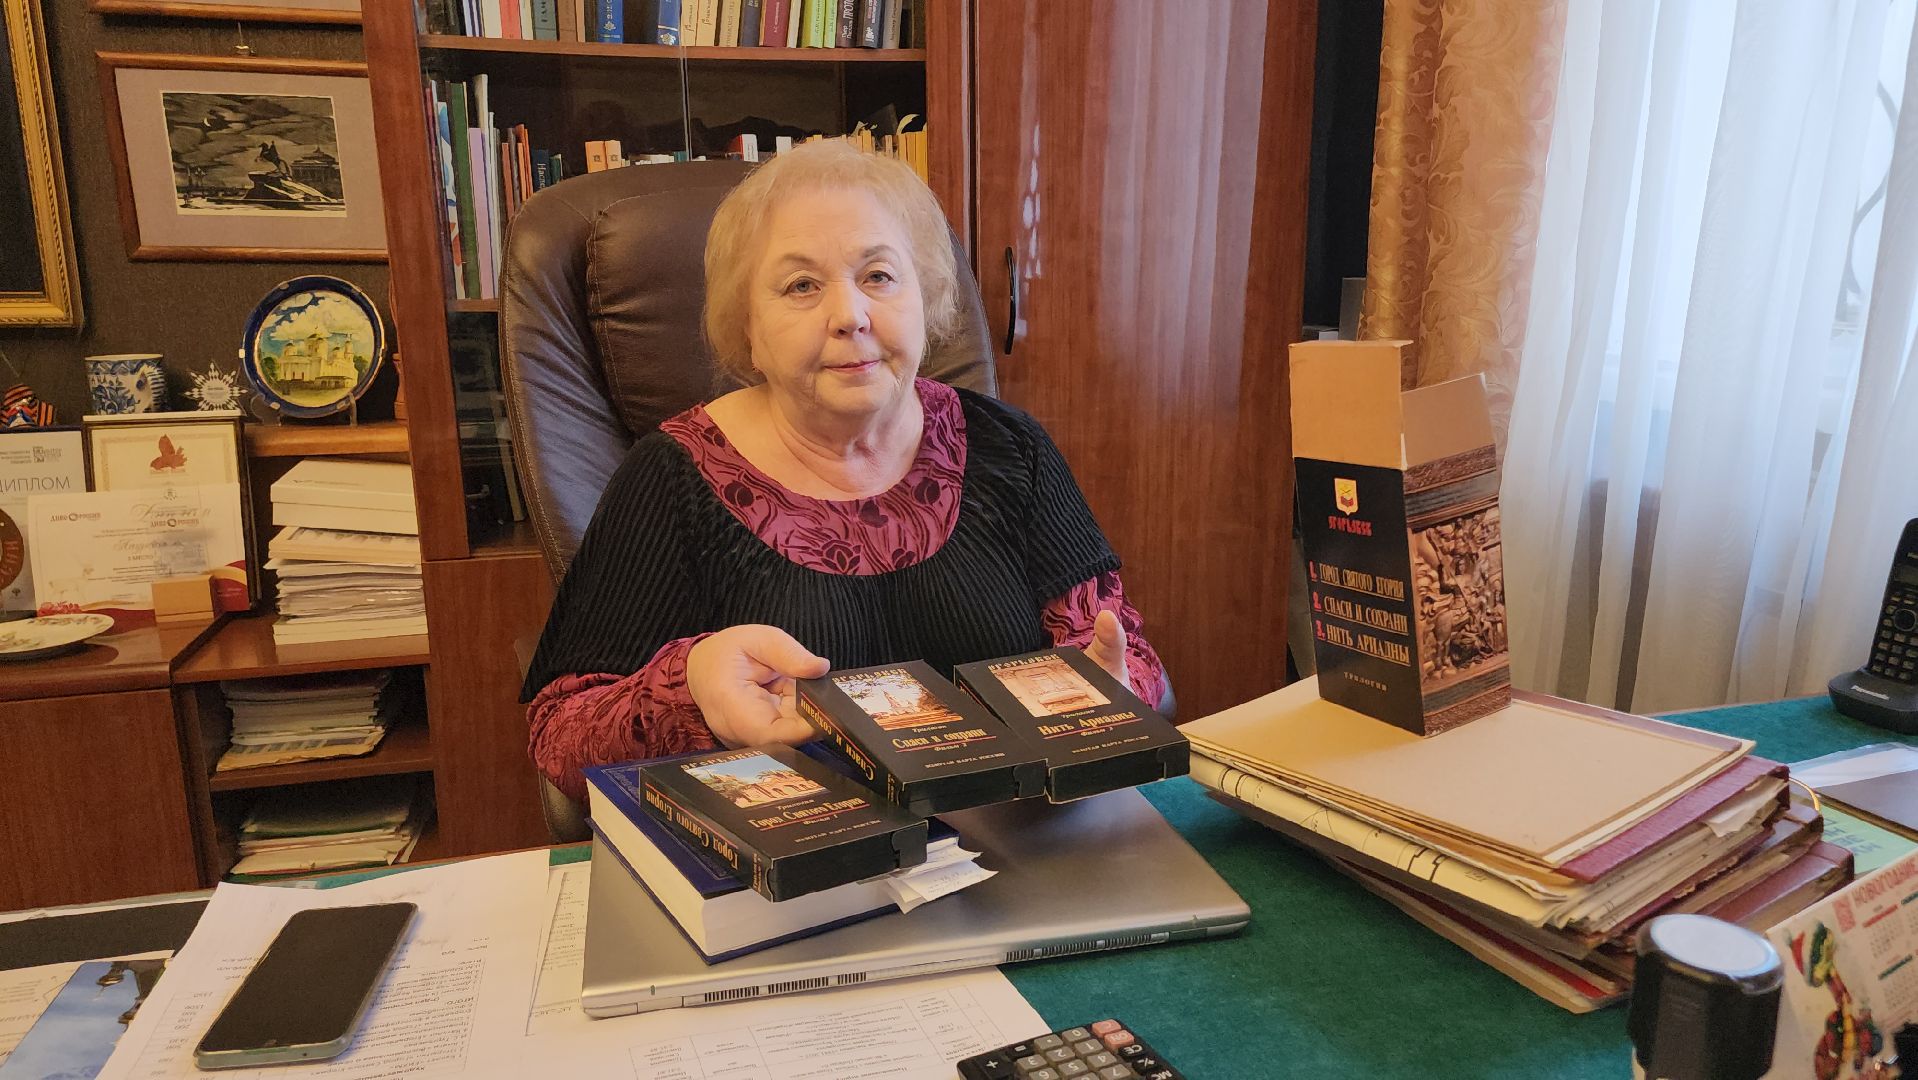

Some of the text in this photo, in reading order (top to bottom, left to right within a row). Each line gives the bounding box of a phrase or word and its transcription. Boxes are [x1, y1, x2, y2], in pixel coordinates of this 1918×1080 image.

[1319, 563, 1339, 587] ГОРОД
[1343, 568, 1372, 591] СВЯТОГО
[1376, 574, 1405, 599] ЕГОРИЯ
[1324, 595, 1352, 619] СПАСИ
[1355, 603, 1363, 620] И
[1365, 604, 1408, 633] СОХРАНИ
[1326, 624, 1354, 648] НИТЬ
[1356, 633, 1409, 664] АРИАДНЫ
[799, 698, 875, 781] Спаси и сохрани
[892, 728, 988, 749] Спаси и сохрани
[1037, 711, 1137, 736] Нить Ариадны
[645, 789, 740, 870] Город Святого Егория
[748, 797, 866, 829] Город Святого Егория
